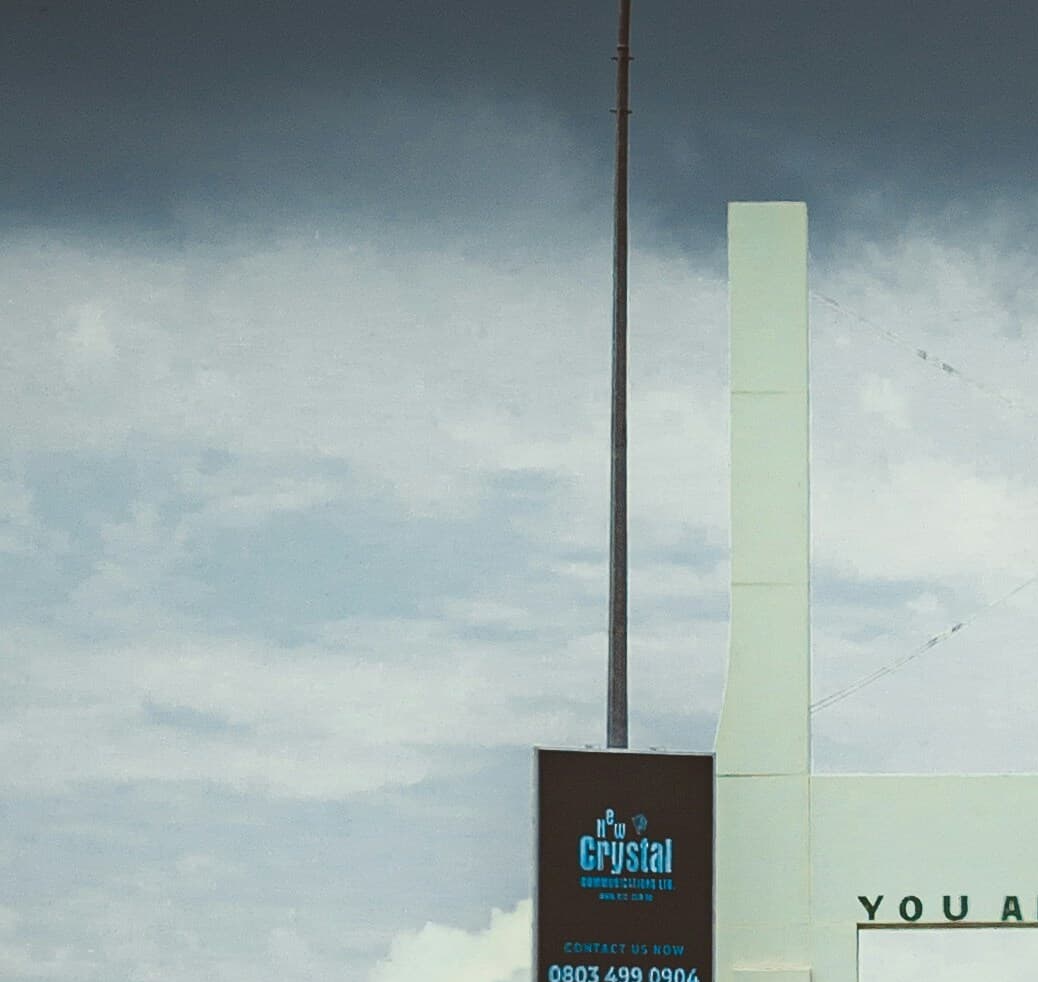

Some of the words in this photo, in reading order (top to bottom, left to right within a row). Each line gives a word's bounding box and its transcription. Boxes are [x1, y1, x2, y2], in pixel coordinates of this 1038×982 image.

[580, 836, 672, 874] Crystal
[857, 895, 969, 922] YOU
[564, 941, 626, 954] CONTACT
[631, 943, 648, 955] US
[653, 944, 685, 956] NOW
